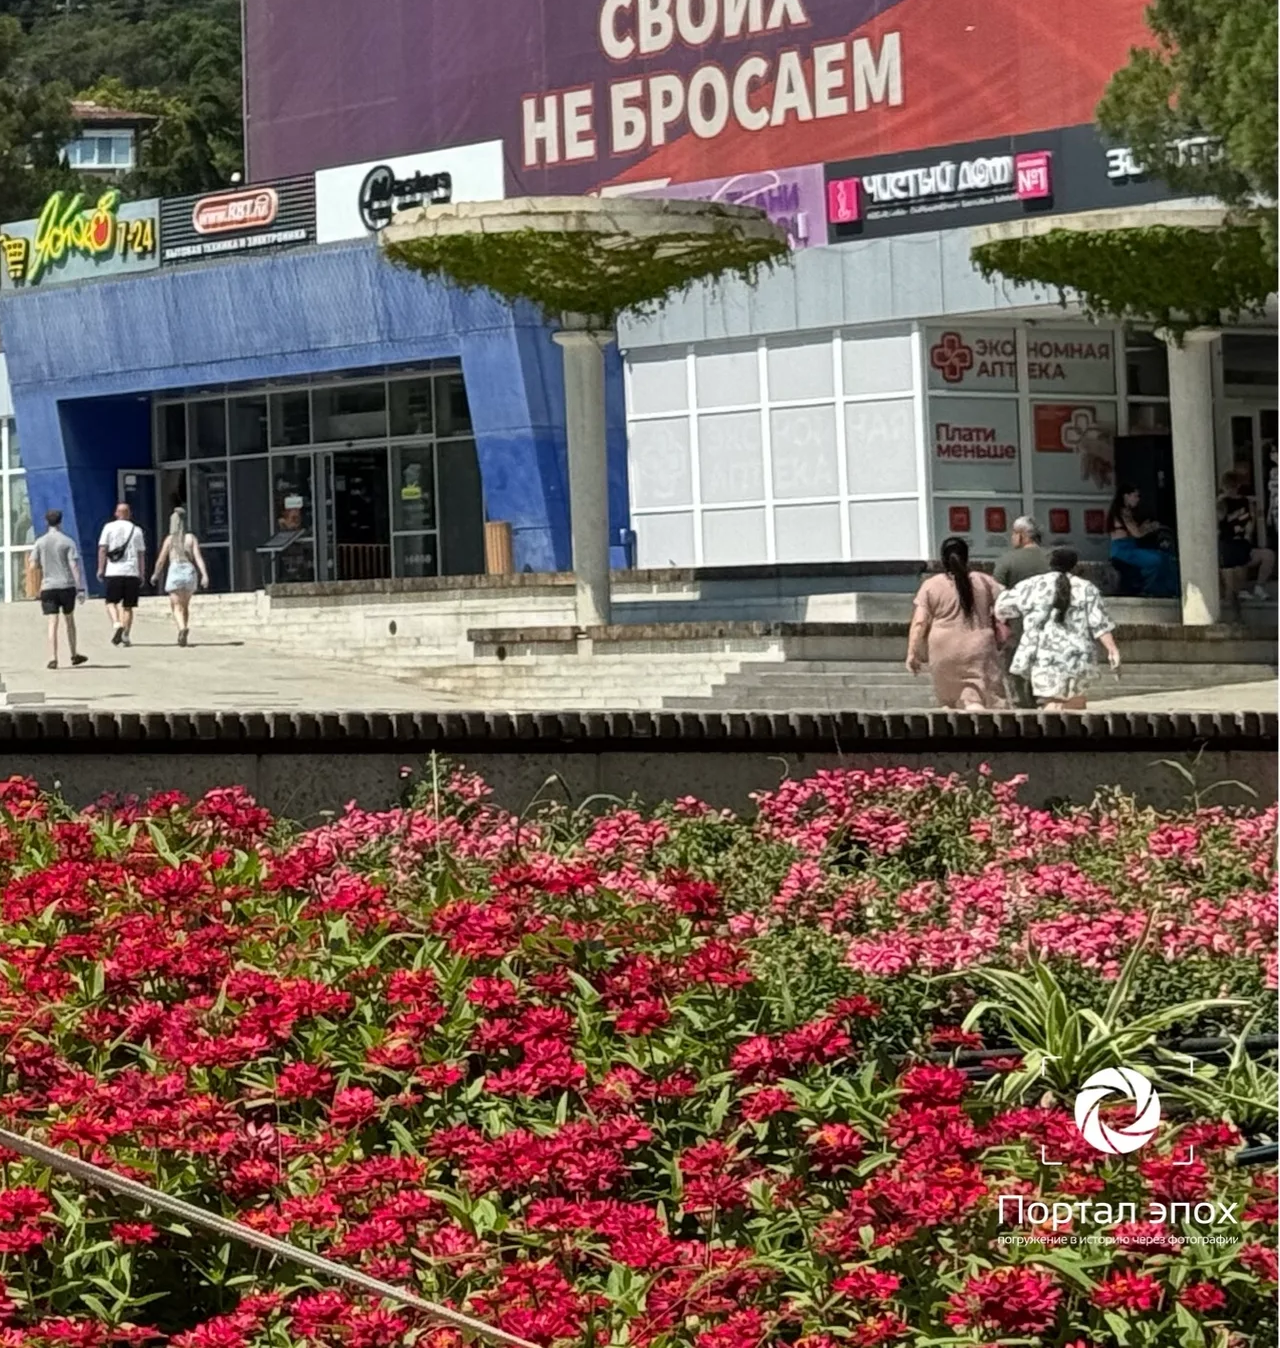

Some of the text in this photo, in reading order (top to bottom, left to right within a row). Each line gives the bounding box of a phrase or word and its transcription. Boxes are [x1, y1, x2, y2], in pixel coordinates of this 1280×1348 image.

[522, 31, 904, 166] НЕ БРОСАЕМ
[974, 338, 1111, 361] ЭКОНОМНАЯ
[976, 361, 1067, 380] АПТЕКА
[935, 423, 995, 443] Плати
[936, 443, 1016, 460] меньше
